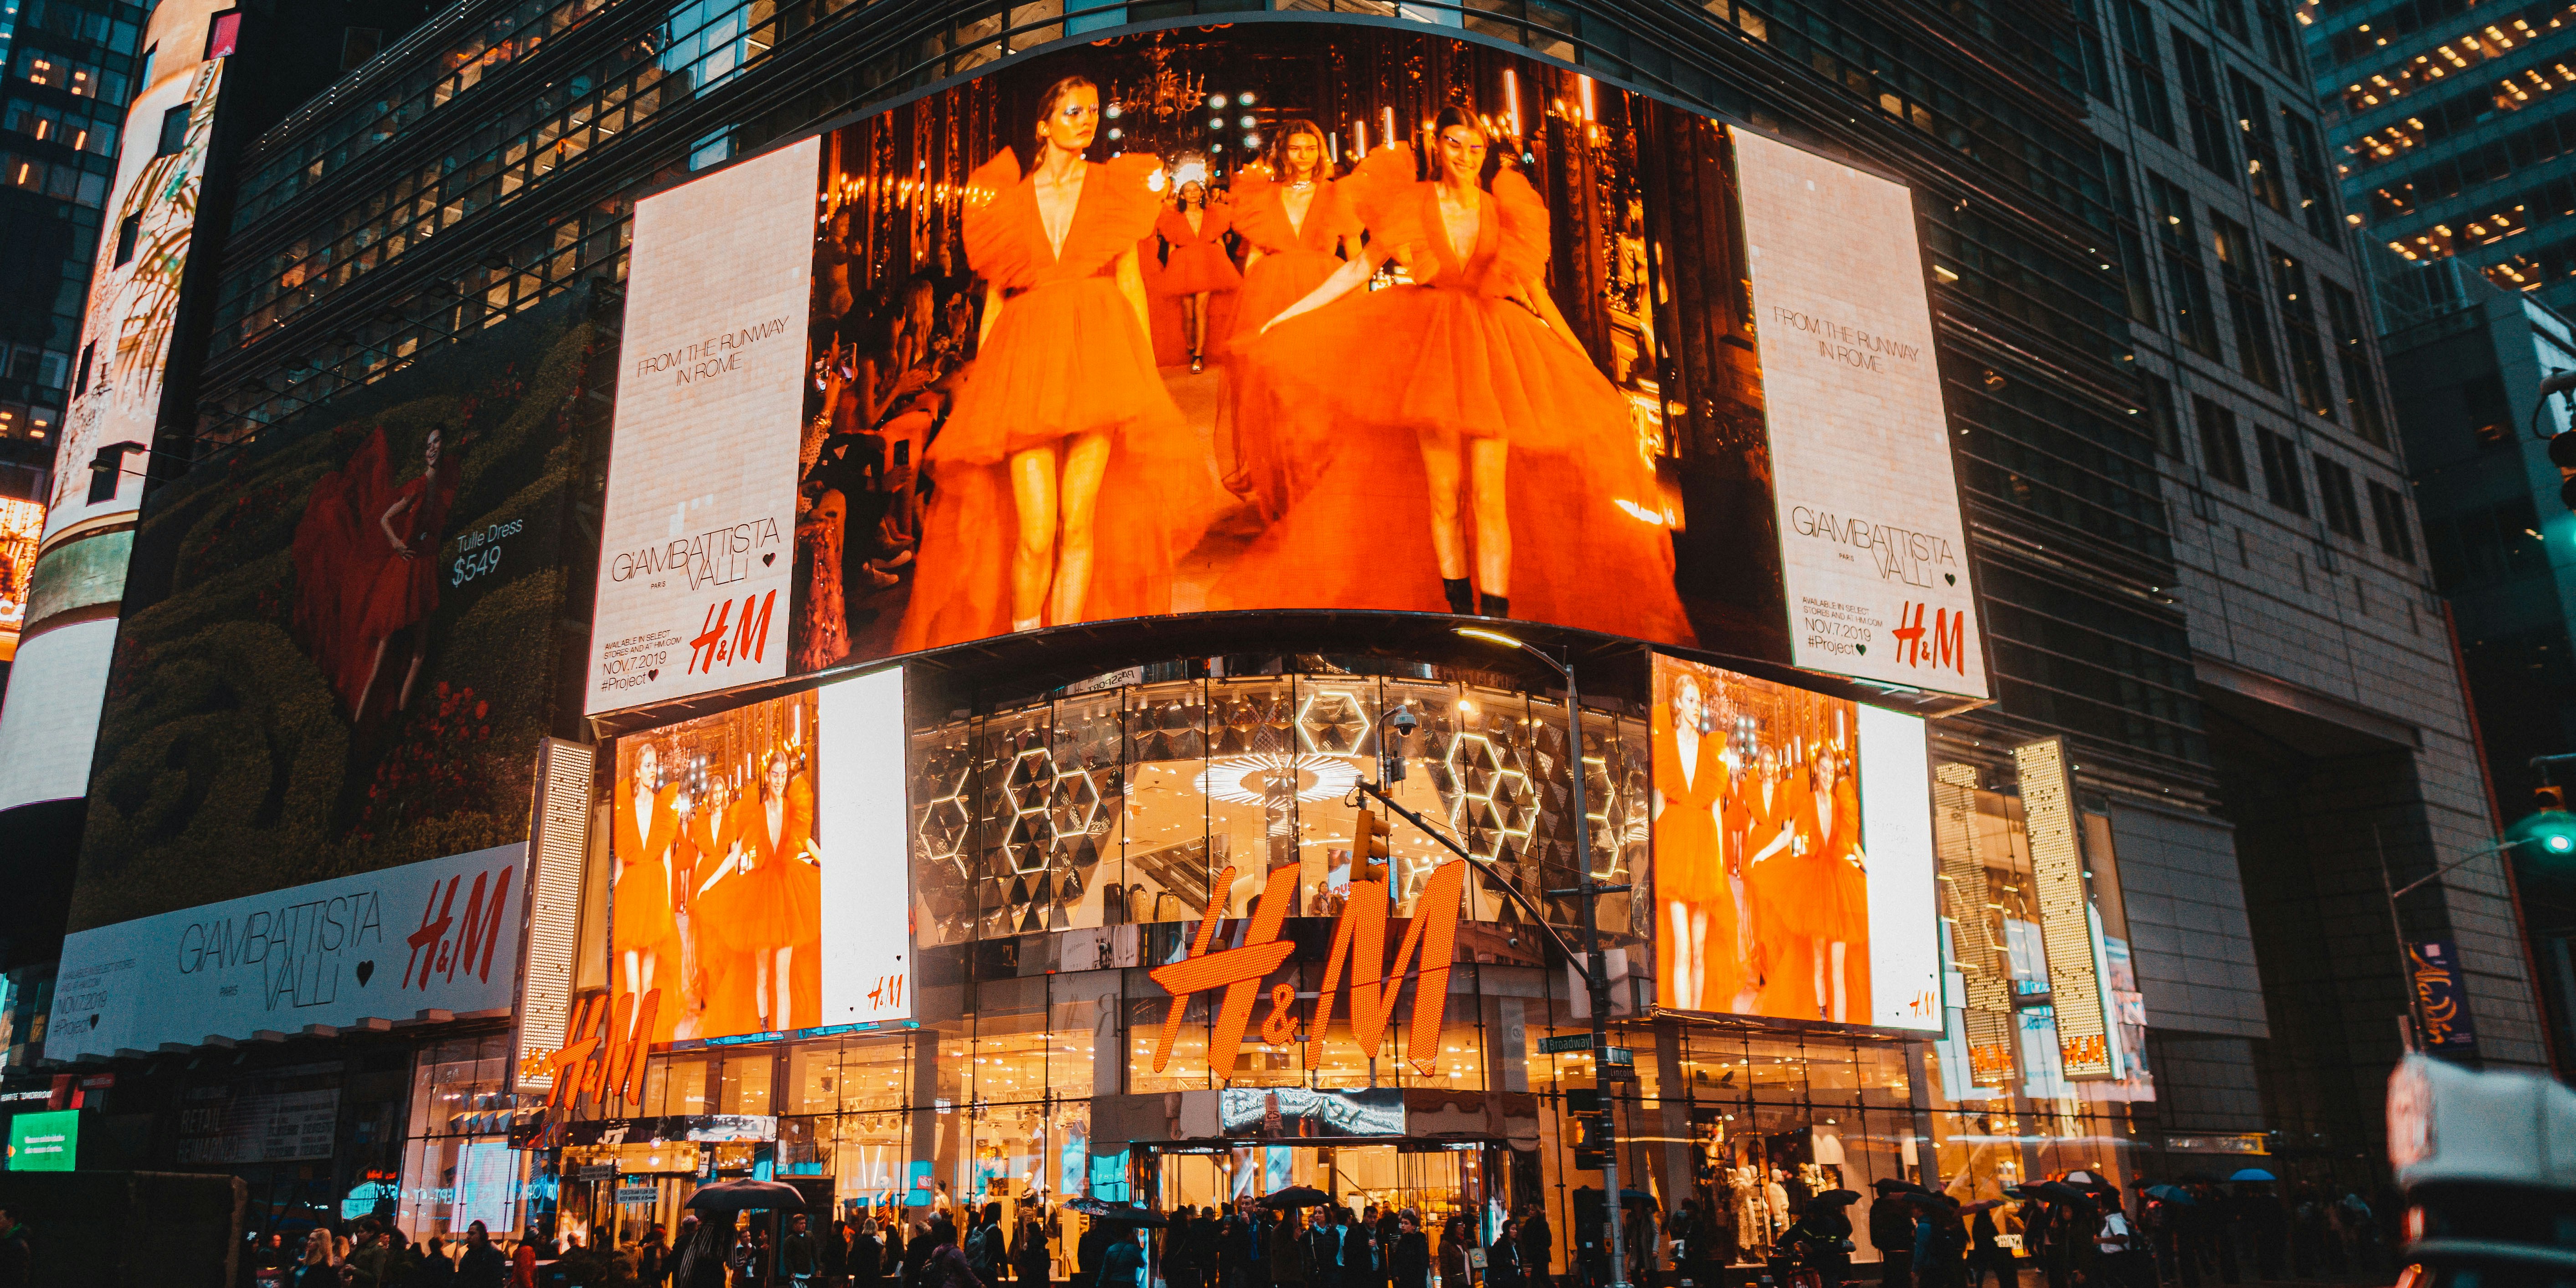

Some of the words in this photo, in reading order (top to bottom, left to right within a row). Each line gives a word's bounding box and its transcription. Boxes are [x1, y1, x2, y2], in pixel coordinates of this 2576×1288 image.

[638, 349, 681, 377] FROM
[687, 338, 716, 362] THE
[720, 315, 790, 351] RUNWAY
[1774, 306, 1820, 334] FROM
[1823, 320, 1855, 345] THE
[1857, 330, 1919, 362] RUNWAY
[677, 368, 691, 386] IN
[695, 351, 743, 381] ROME
[1820, 341, 1834, 359] IN
[1837, 345, 1883, 374] ROME
[457, 531, 484, 553] Tulle
[488, 519, 523, 543] Dress
[452, 545, 501, 588] $549
[1839, 553, 1854, 561] PARIS
[651, 581, 666, 590] PARIS
[1802, 596, 1836, 610] AVAILABLE
[1846, 605, 1870, 615] SELECT
[1803, 606, 1830, 617] STORES
[1831, 611, 1846, 620] AND
[1856, 615, 1883, 627] HM.COM
[605, 637, 637, 651] AVAILABLE
[646, 630, 671, 641] SELECT
[688, 589, 776, 675] H&M
[1805, 617, 1872, 641] NOV.7.2019
[1892, 600, 1964, 677] H&M
[604, 649, 629, 659] STORES
[630, 645, 644, 653] AND
[645, 643, 653, 651] AT
[654, 636, 682, 649] HM.COM
[1808, 635, 1855, 656] #Project
[602, 651, 667, 676] NOV.7.2019
[602, 672, 647, 692] #Project
[402, 865, 513, 991] H&M
[1149, 859, 1465, 1081] H&M
[547, 988, 660, 1111] H&M
[1549, 1037, 1590, 1051] Broadway
[2062, 1035, 2104, 1066] H&M
[1621, 1051, 1627, 1062] 42
[1610, 1068, 1633, 1077] Lincoln
[20, 1091, 53, 1100] TOMORROW
